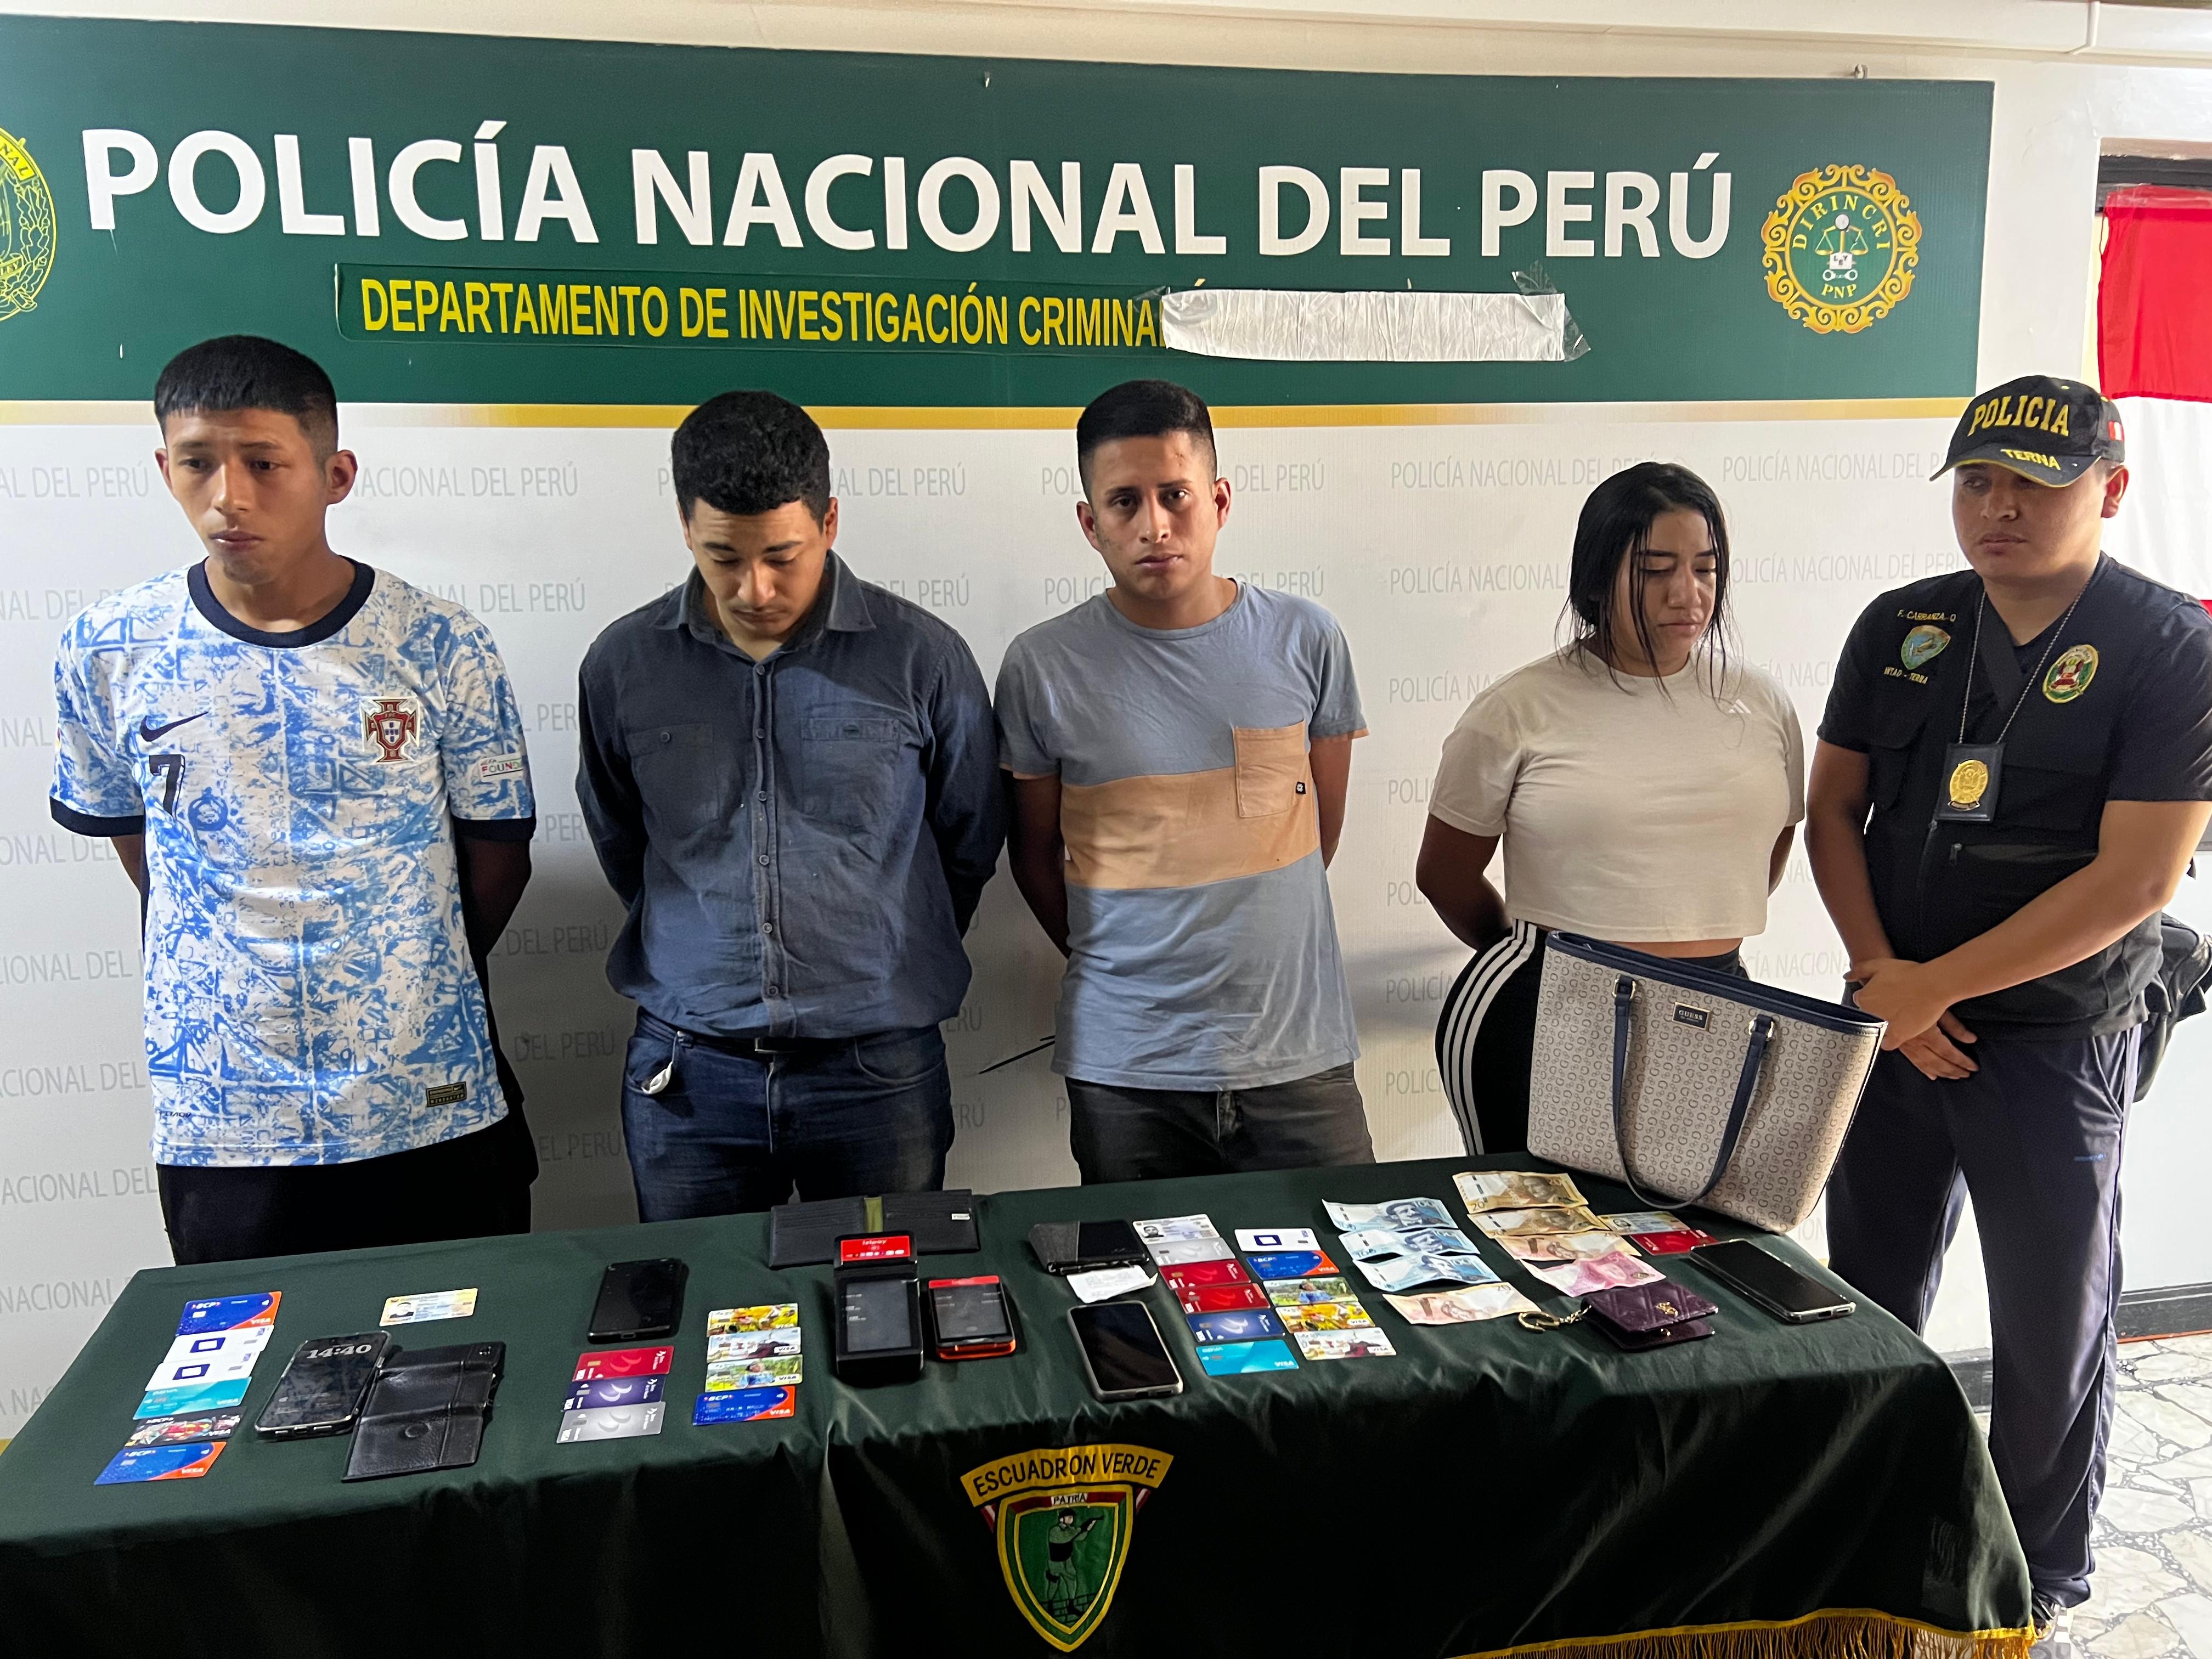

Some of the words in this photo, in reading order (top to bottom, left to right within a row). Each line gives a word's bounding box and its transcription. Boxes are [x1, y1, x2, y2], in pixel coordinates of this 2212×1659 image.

[82, 120, 599, 243] POLICÍA
[631, 149, 1226, 255] NACIONAL
[1259, 165, 1451, 257] DEL
[1481, 153, 1731, 259] PERÚ
[1792, 194, 1891, 250] DIRINCRI
[1821, 283, 1857, 298] PNP
[362, 279, 668, 337] DEPARTAMENTO
[680, 287, 729, 338] DE
[739, 281, 1008, 346] INVESTIGACIÓN
[1967, 395, 2069, 437] POLICIA
[1235, 465, 1270, 492] DEL
[1277, 458, 1324, 492] PERÚ
[1391, 455, 1463, 489] POLICÍA
[1470, 459, 1566, 487] NACIONAL
[1723, 448, 1791, 482] POLICÍA
[1797, 453, 1887, 481] NACIONAL
[1892, 453, 1925, 479] DEL
[2001, 449, 2061, 471] TERNA
[32, 467, 80, 498] DEL
[87, 461, 149, 498] PERÚ
[471, 467, 515, 497] DEL
[522, 460, 578, 496] PERÚ
[869, 468, 908, 496] DEL
[913, 462, 966, 496] PERÚ
[1390, 561, 1462, 595] POLICÍA
[1469, 563, 1565, 592] NACIONAL
[1731, 552, 1787, 584] OLICÍA
[1793, 554, 1883, 583] NACIONAL
[1887, 554, 1919, 579] DEL
[480, 584, 523, 613] DEL
[529, 577, 585, 612] PERÚ
[918, 572, 969, 607] PERÚ
[1389, 670, 1461, 703] POLICÍA
[537, 703, 578, 731] PER
[149, 754, 185, 821] 7
[545, 814, 585, 842] PER
[72, 834, 119, 863] DEL
[505, 929, 548, 957] DEL
[552, 919, 608, 953] PERÚ
[86, 950, 133, 980] DEL
[1678, 1009, 1703, 1021] GUESS
[514, 1034, 556, 1062] DEL
[560, 1025, 615, 1059] PERÚ
[100, 1062, 146, 1092] DEL
[568, 1126, 622, 1160] PERÚ
[2, 1170, 107, 1205] ACIONAL
[112, 1167, 157, 1197] DEL
[1472, 1201, 1485, 1211] 20
[306, 1344, 372, 1359] 14:40
[972, 1454, 1096, 1497] ESCUADRON
[1102, 1453, 1161, 1479] VERDE
[1053, 1493, 1087, 1504] PATRIA
